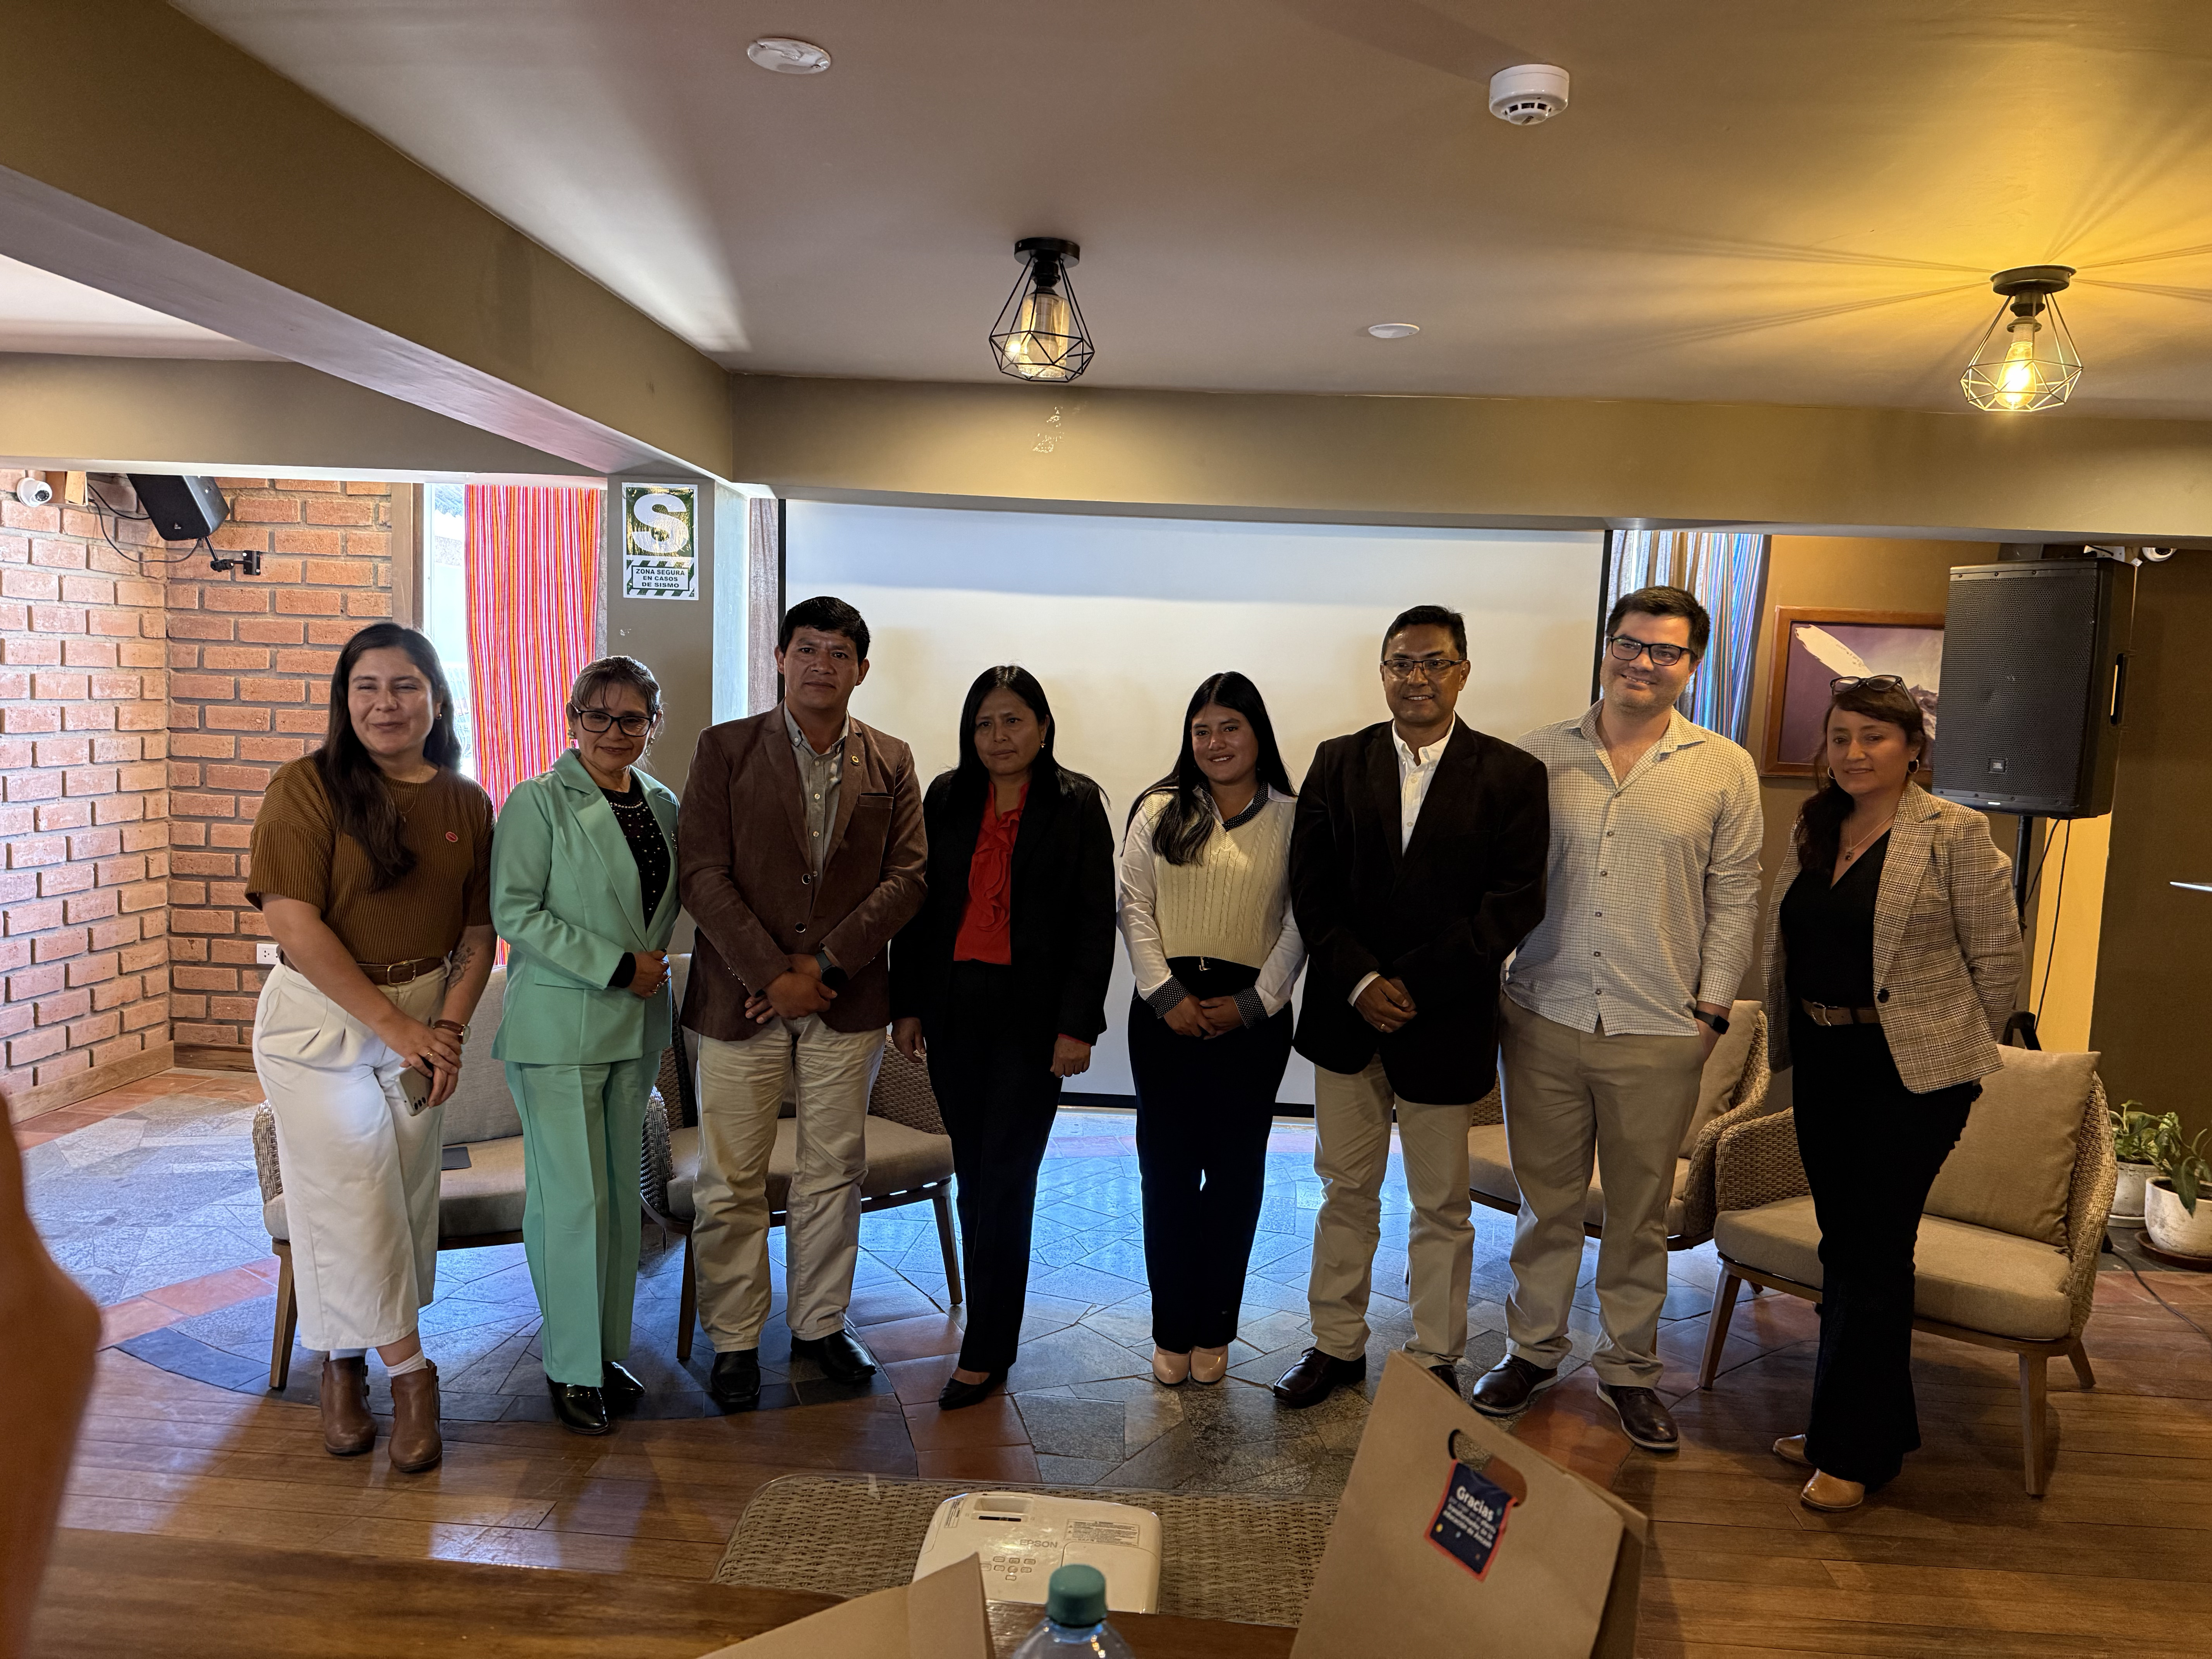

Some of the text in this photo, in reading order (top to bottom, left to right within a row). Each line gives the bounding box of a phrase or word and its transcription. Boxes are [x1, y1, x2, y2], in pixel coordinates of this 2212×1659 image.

[632, 493, 689, 553] S
[1456, 1485, 1494, 1522] Gracias
[1020, 1539, 1058, 1548] EPSON
